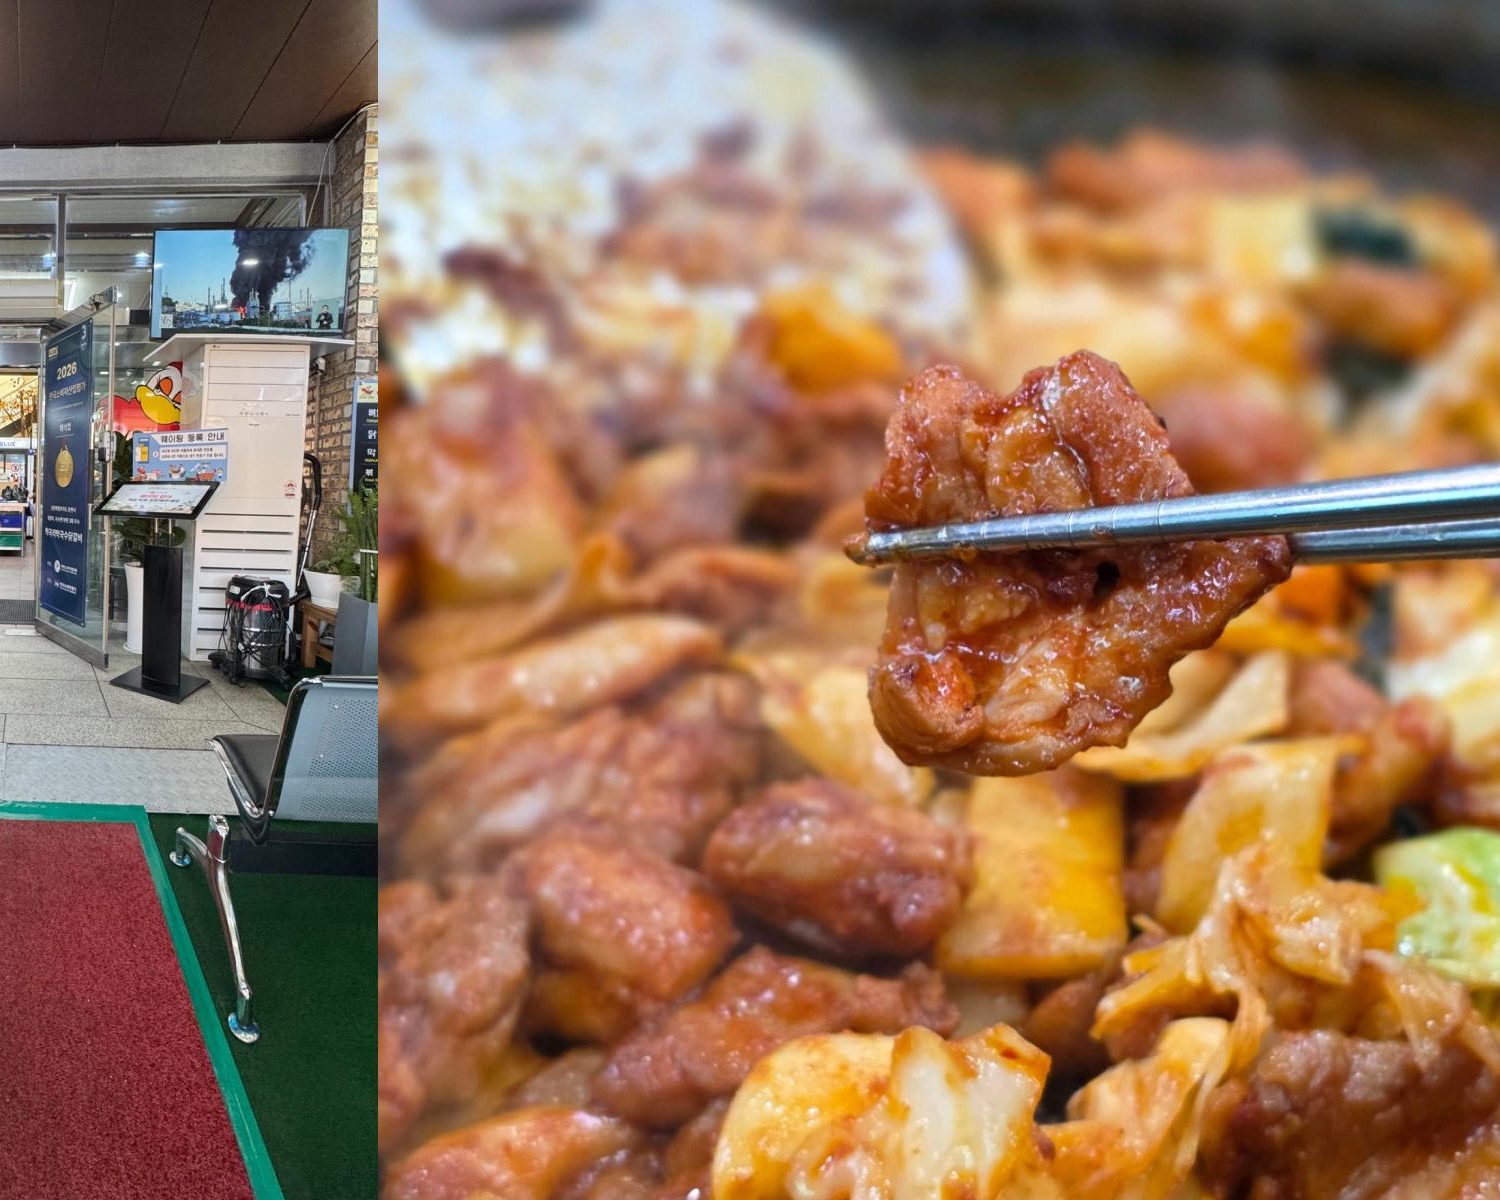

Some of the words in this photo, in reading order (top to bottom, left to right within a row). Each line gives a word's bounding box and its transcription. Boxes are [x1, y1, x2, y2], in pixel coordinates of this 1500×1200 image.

[81, 324, 87, 340] 3
[56, 361, 77, 380] 2026
[160, 434, 183, 443] 웨이팅
[188, 433, 203, 442] 등록
[207, 432, 225, 441] 안내
[367, 448, 377, 457] 막
